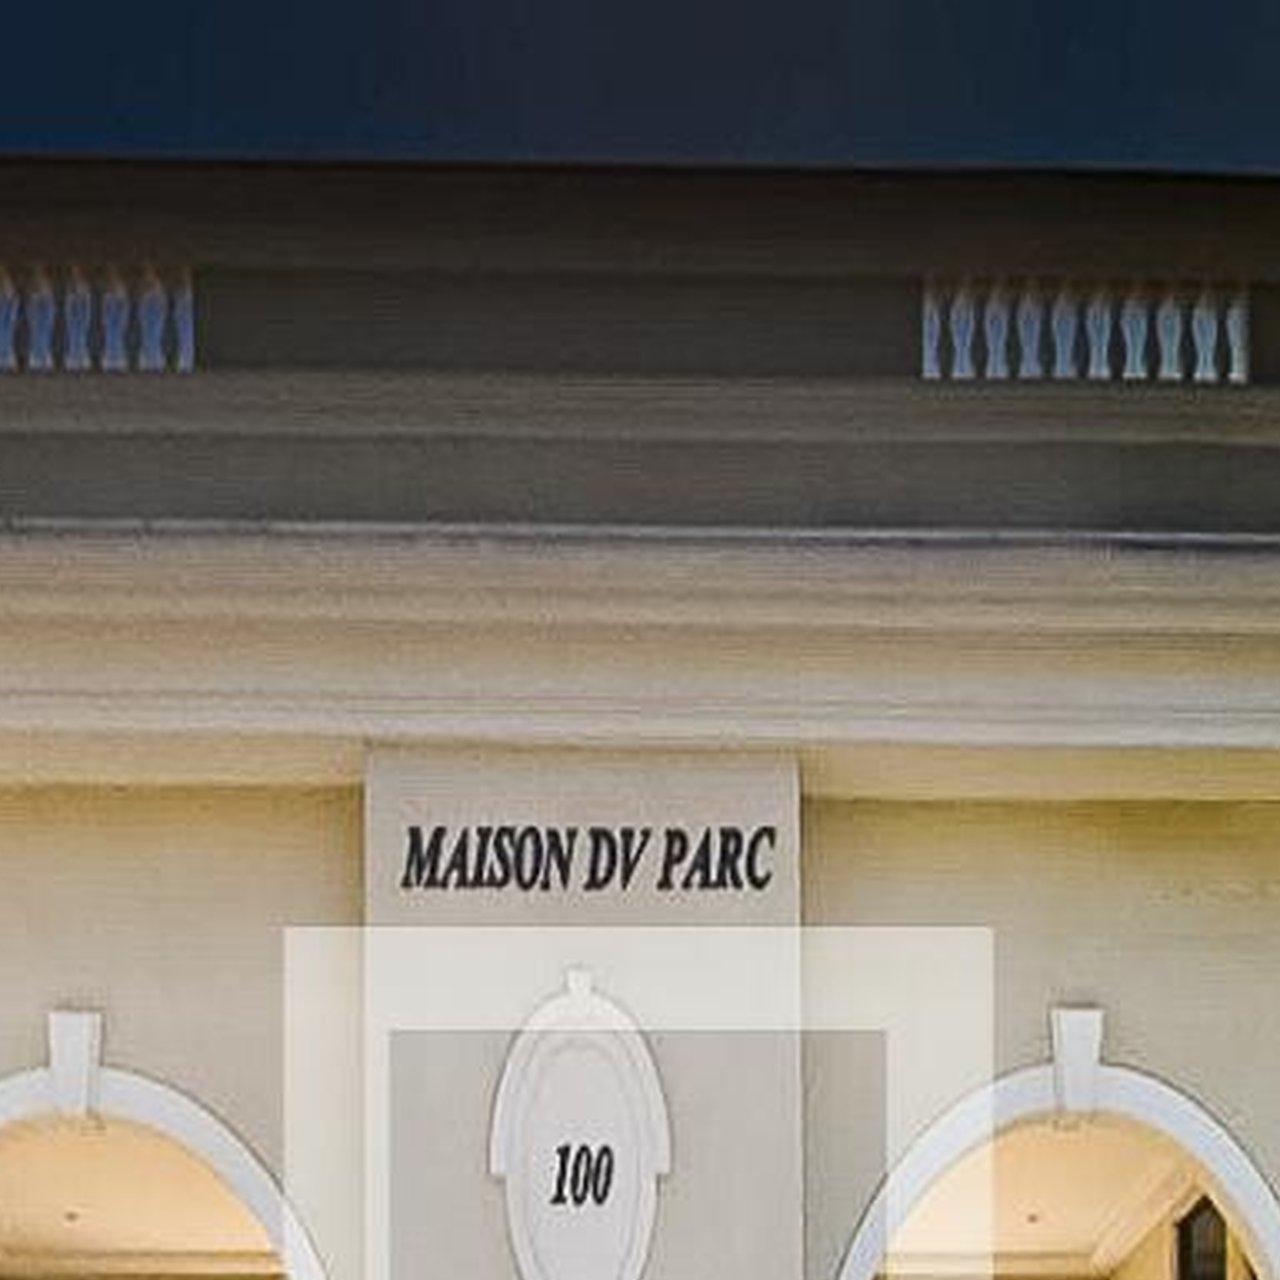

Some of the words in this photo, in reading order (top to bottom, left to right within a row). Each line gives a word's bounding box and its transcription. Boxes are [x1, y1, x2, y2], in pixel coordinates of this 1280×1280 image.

[400, 826, 578, 891] MAISON
[583, 826, 652, 891] DV
[656, 826, 776, 891] PARC
[549, 1143, 614, 1206] 100
